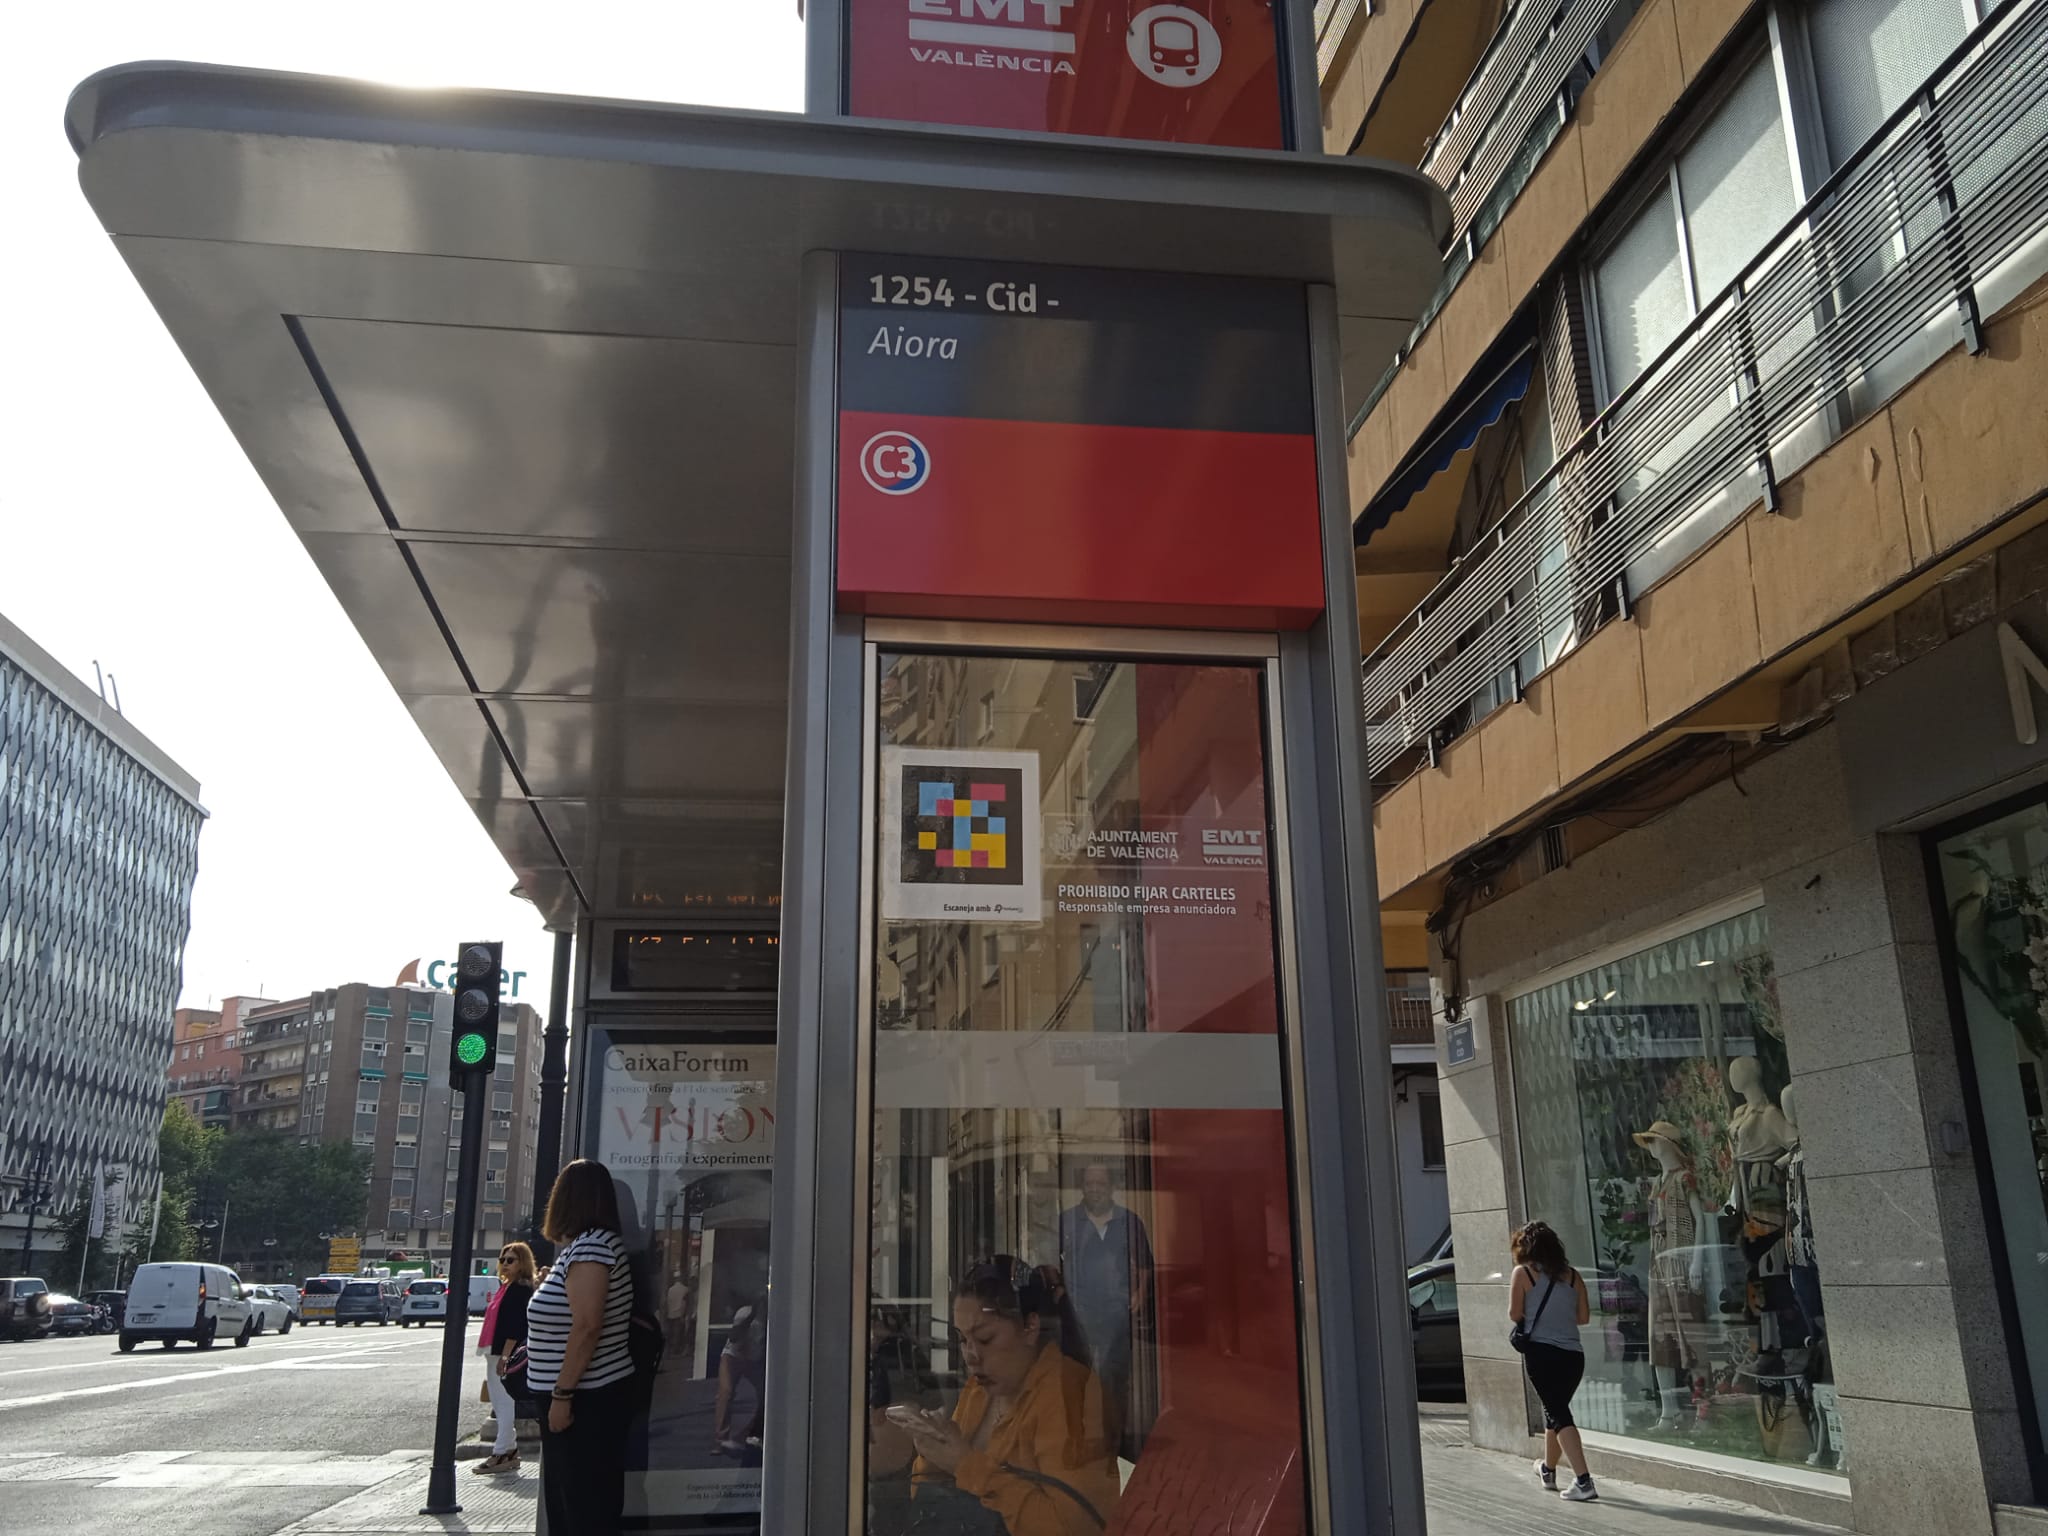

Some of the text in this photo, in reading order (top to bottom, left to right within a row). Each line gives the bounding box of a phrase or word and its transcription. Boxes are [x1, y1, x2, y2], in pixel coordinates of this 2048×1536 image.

[909, 0, 1075, 26] EMT
[910, 46, 1077, 76] VALÈNCIA
[869, 274, 955, 308] 1254
[964, 293, 977, 301] -
[986, 282, 1038, 313] Cid
[867, 325, 959, 360] Aiora
[873, 444, 918, 480] C3
[1087, 830, 1179, 844] AJUNTAMENT
[1202, 829, 1263, 844] EMT
[1087, 844, 1179, 860] DE VALÈNCIA
[1203, 856, 1264, 866] VALÈNCIA
[1058, 884, 1237, 902] PROHIBIDO FIJAR CARTELES
[943, 903, 975, 914] Escaneja
[975, 904, 992, 912] amb
[1059, 902, 1237, 916] Responsable empresa anunciadora
[605, 1049, 750, 1073] CaixaForum
[654, 1082, 674, 1094] fins
[692, 1151, 774, 1168] experiment
